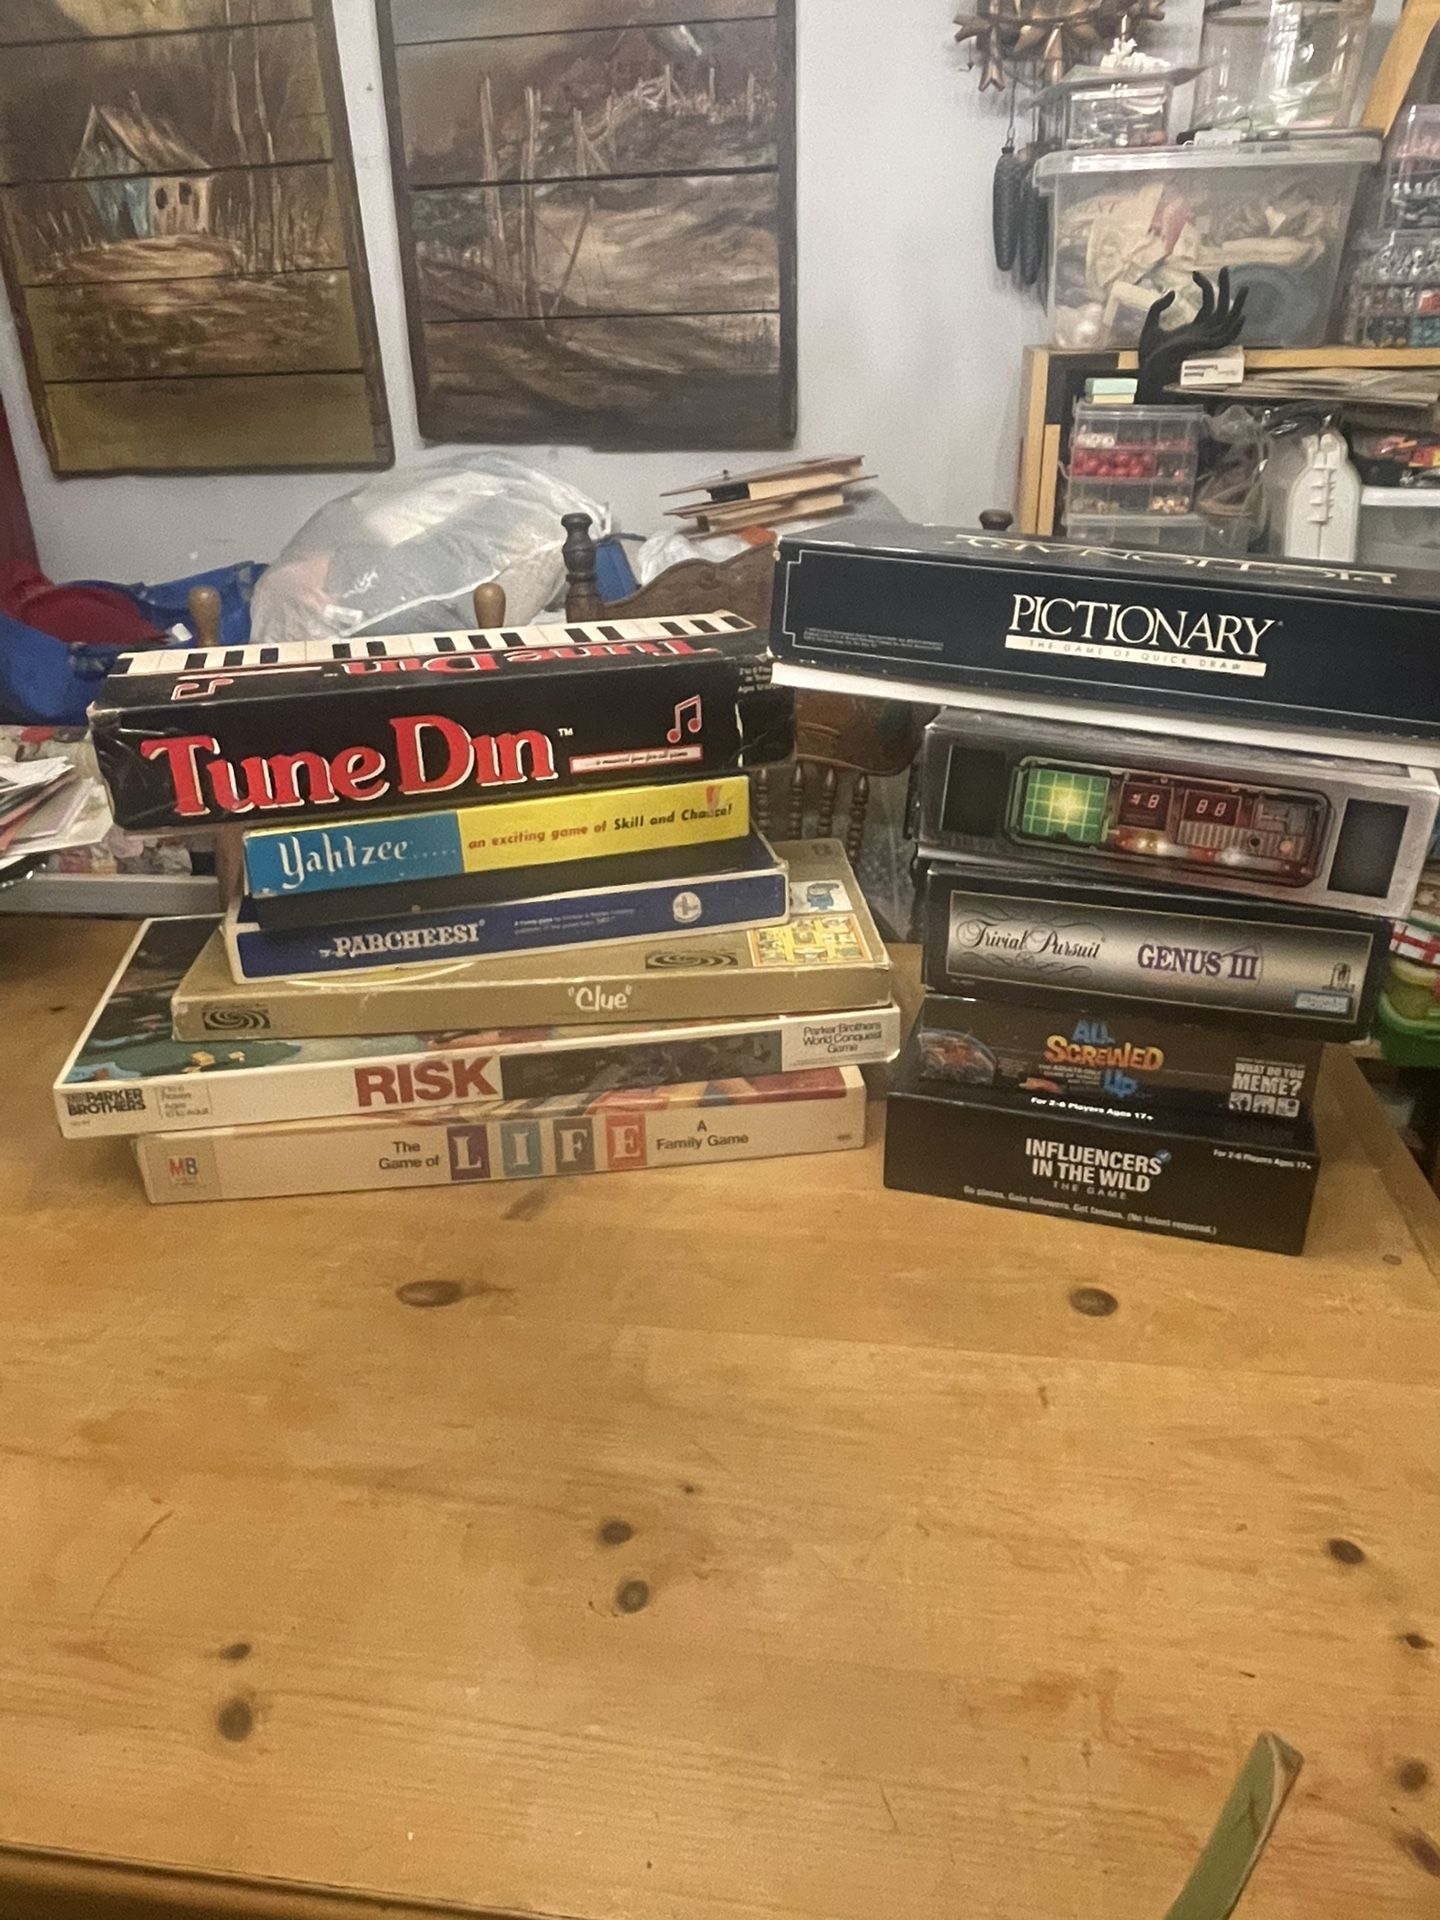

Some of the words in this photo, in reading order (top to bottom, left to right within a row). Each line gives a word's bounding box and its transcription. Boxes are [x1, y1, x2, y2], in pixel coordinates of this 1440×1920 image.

[1009, 594, 1276, 657] PICTIONARY
[1029, 639, 1054, 650] THE
[1064, 643, 1104, 656] GAME
[1113, 650, 1131, 658] OF
[1141, 652, 1188, 666] QUICK
[1199, 659, 1241, 671] DRAW
[468, 838, 486, 850] an
[491, 830, 545, 847] exciting
[551, 824, 588, 842] game
[593, 820, 608, 833] of
[613, 814, 645, 832] Skill
[649, 811, 676, 826] and
[332, 921, 481, 958] PARCHEESI
[956, 918, 1029, 951] Trivial
[1025, 924, 1102, 960] Pursuit
[1136, 943, 1222, 978] GENUS
[1228, 952, 1260, 981] III
[803, 1026, 837, 1037] Parker
[838, 1022, 882, 1034] Brothers
[803, 1034, 833, 1046] World
[833, 1030, 882, 1044] Conquest
[1070, 1019, 1116, 1045] ALL
[827, 1043, 859, 1054] Game
[354, 1056, 498, 1107] RISK
[1234, 1062, 1265, 1075] WHAT
[1266, 1066, 1282, 1077] DO
[1284, 1068, 1305, 1080] YOU
[1231, 1071, 1303, 1097] MEME?
[86, 1087, 143, 1103] PARKER
[67, 1100, 146, 1117] BROTHERS
[1031, 1096, 1048, 1105] For
[1048, 1099, 1066, 1108] 2-6
[1067, 1102, 1105, 1114] Players
[1106, 1108, 1132, 1118] Ages
[696, 1119, 708, 1132] A
[392, 1140, 421, 1154] The
[657, 1137, 703, 1151] Family
[708, 1133, 750, 1147] Game
[378, 1156, 422, 1171] Game
[425, 1154, 440, 1168] of
[1025, 1137, 1162, 1176] INFLUENCERS
[1212, 1148, 1227, 1158] For
[169, 1156, 198, 1177] MB
[1031, 1158, 1053, 1177] IN
[1056, 1161, 1096, 1184] THE
[1099, 1169, 1151, 1193] WILD
[1052, 1180, 1079, 1193] THE
[1086, 1185, 1128, 1201] GAME
[963, 1184, 975, 1195] Go
[1072, 1202, 1089, 1214] Get
[1144, 1214, 1171, 1228] talent
